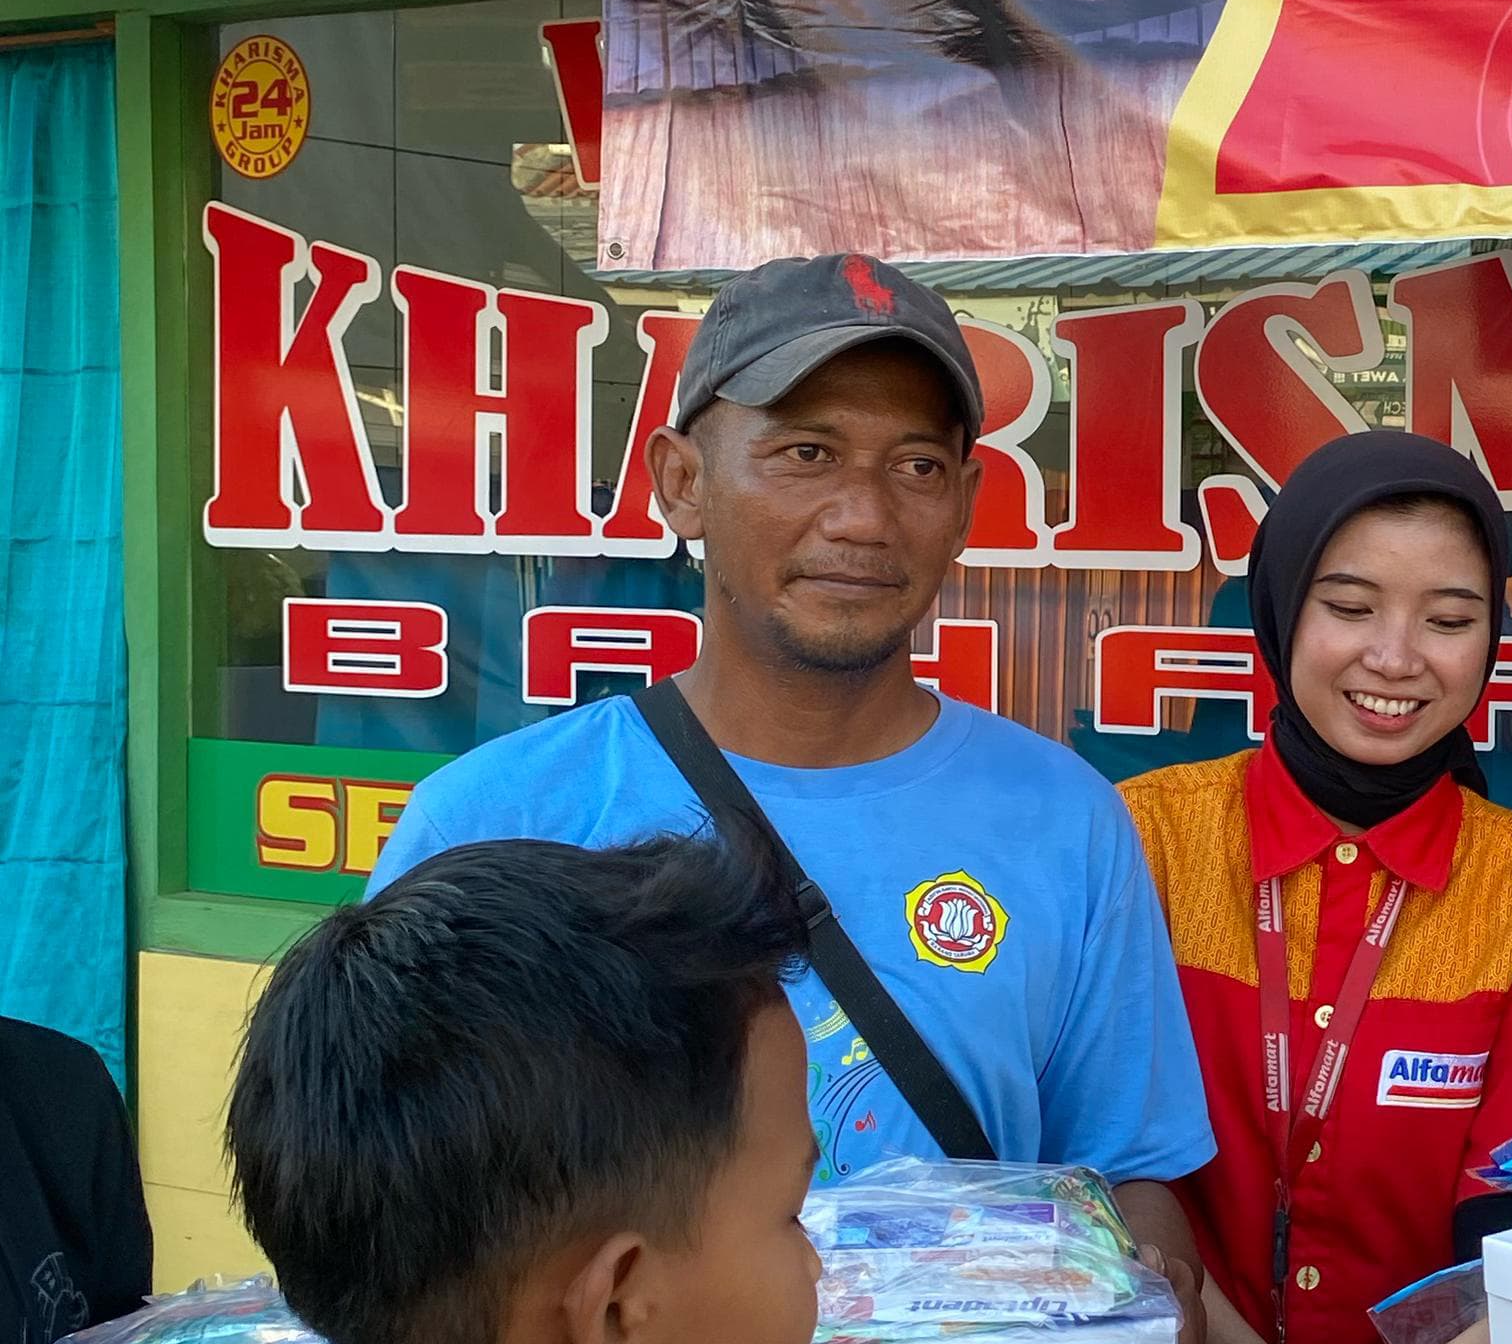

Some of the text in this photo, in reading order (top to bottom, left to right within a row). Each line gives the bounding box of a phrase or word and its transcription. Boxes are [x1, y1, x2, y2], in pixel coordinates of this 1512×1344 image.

[215, 41, 305, 108] KHARISMA
[231, 78, 293, 119] 24
[224, 136, 293, 174] GROUP
[237, 120, 284, 141] Jam
[1365, 878, 1401, 946] Alfamart
[1264, 1032, 1281, 1112] Alfamart
[1304, 1039, 1340, 1118] Alfamart
